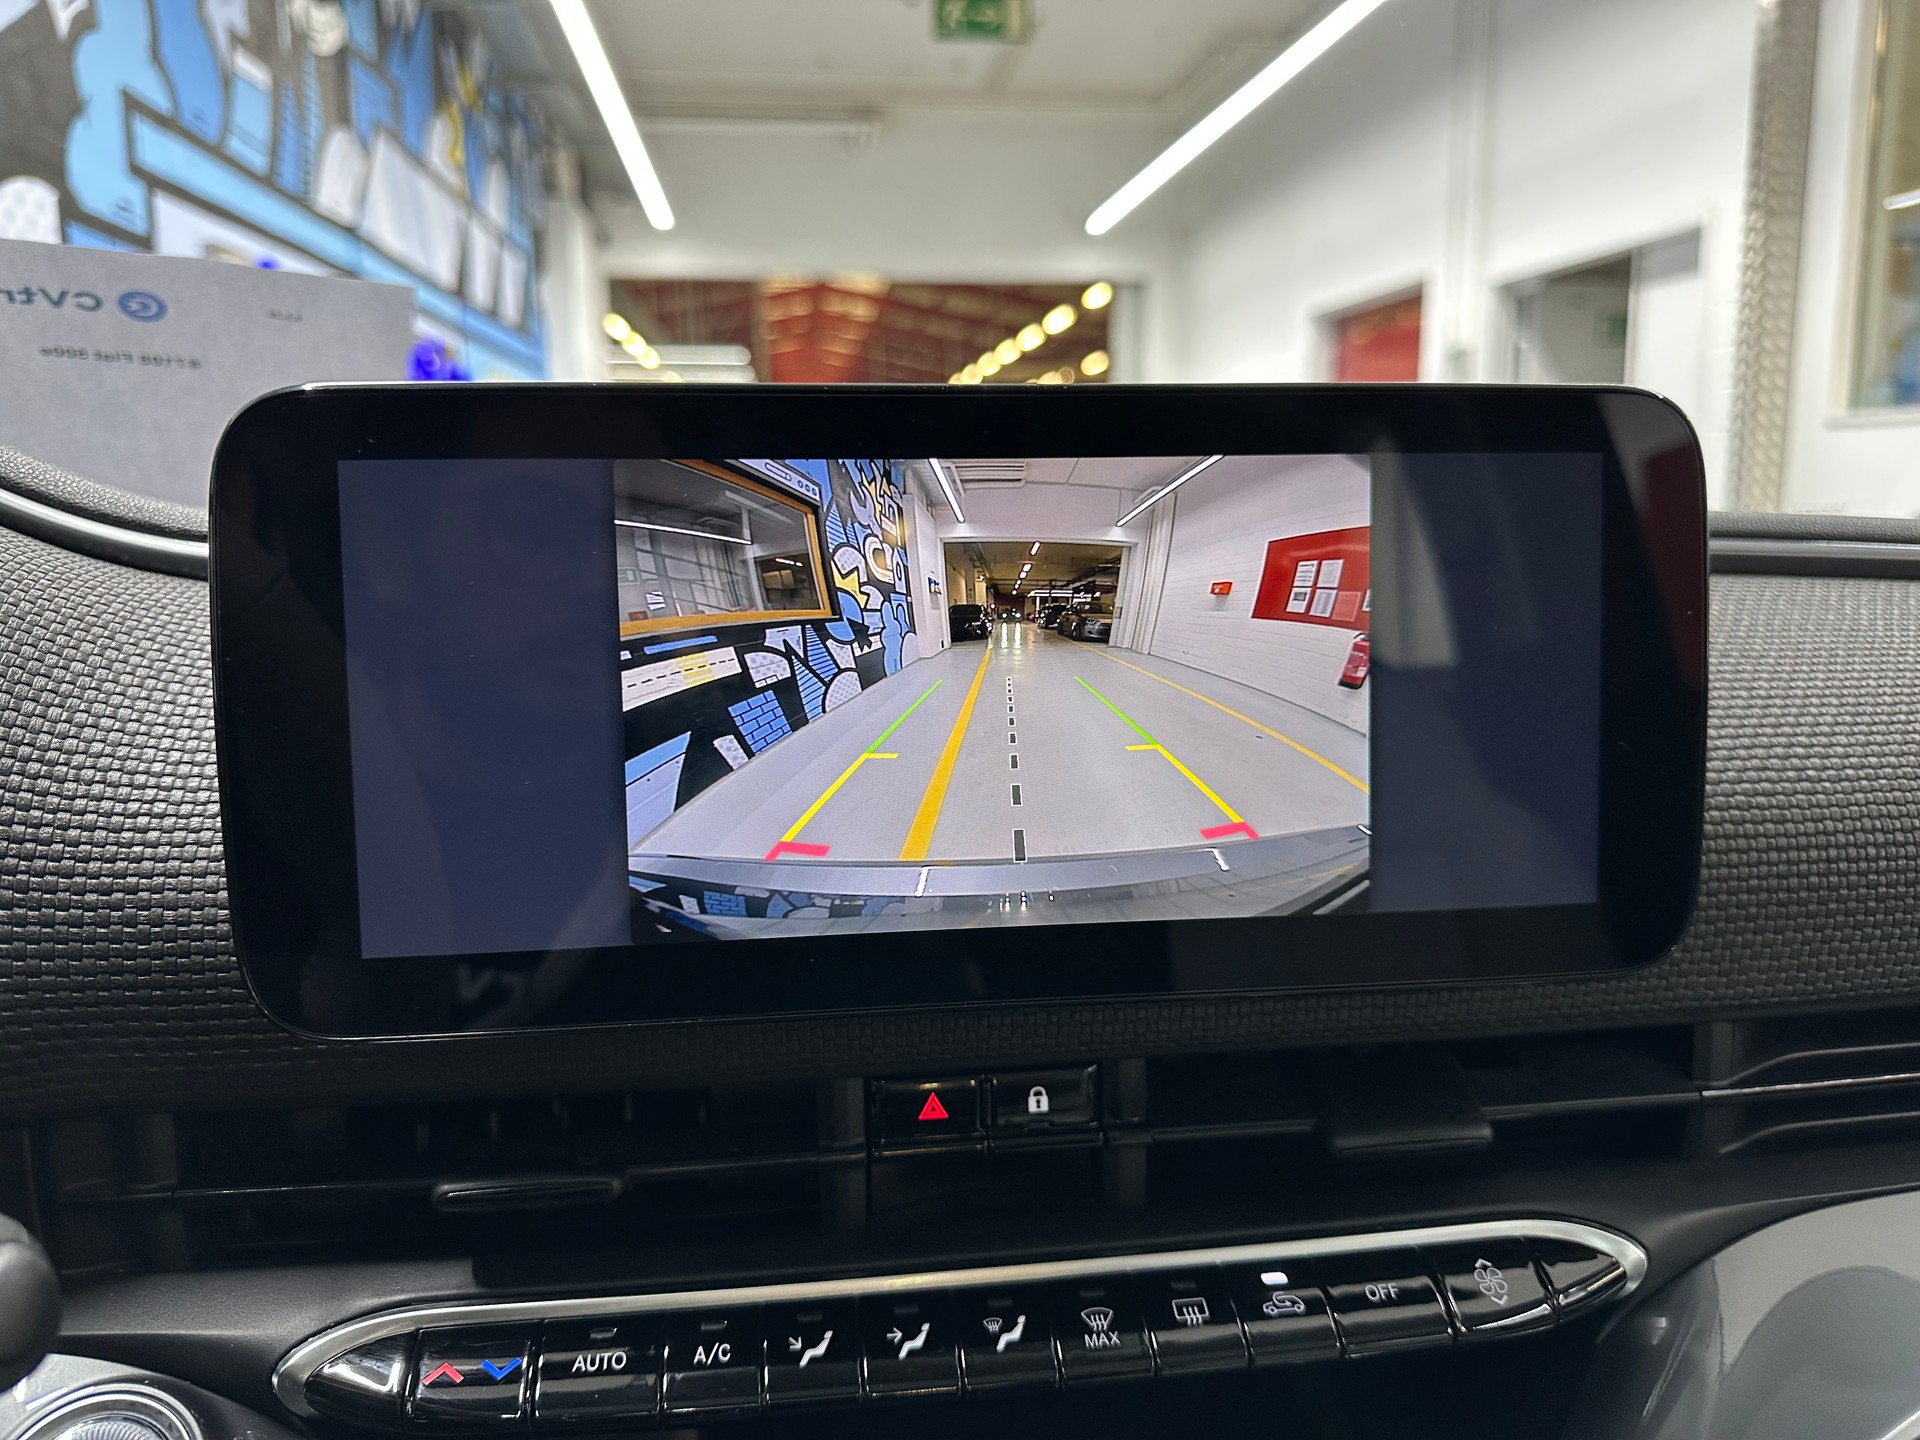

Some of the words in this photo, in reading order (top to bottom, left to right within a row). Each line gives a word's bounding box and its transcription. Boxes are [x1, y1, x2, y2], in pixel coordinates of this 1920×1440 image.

[1365, 1282, 1399, 1301] OFF
[1084, 1331, 1121, 1349] MAX
[572, 1351, 627, 1372] AUTO
[693, 1342, 731, 1366] A/C
